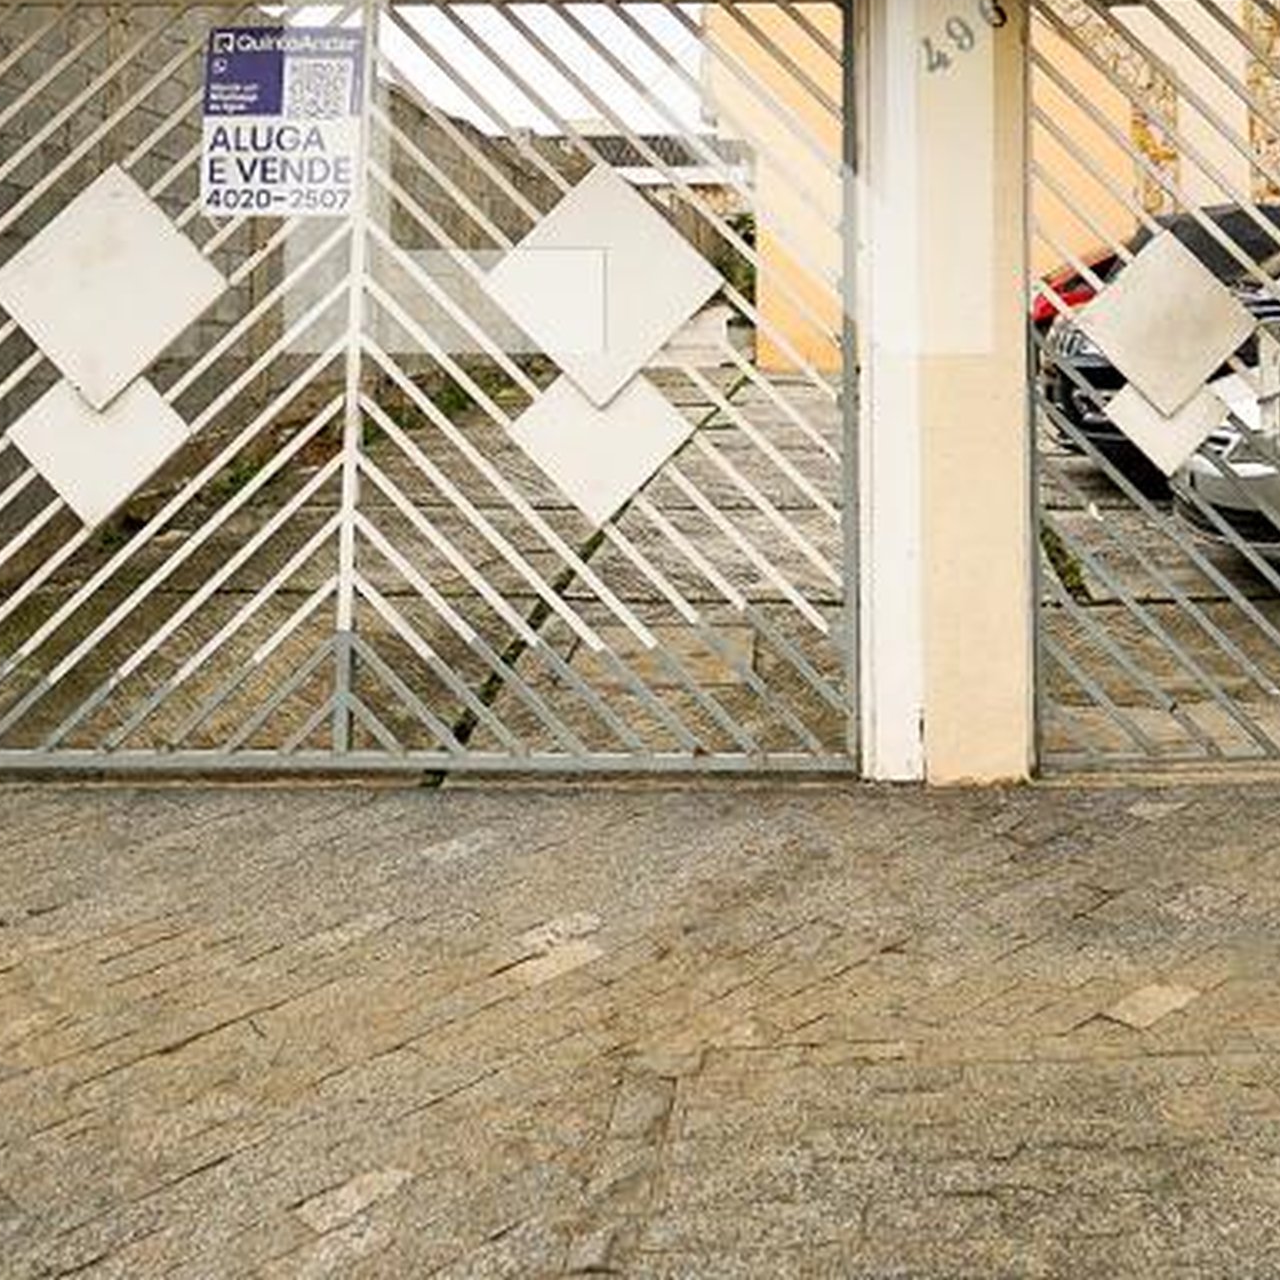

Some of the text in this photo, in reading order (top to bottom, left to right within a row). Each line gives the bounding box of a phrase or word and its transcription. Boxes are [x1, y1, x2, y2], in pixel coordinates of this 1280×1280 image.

[209, 126, 325, 152] ALUGA
[209, 157, 351, 184] E VENDE
[206, 189, 351, 209] 4020-2507
